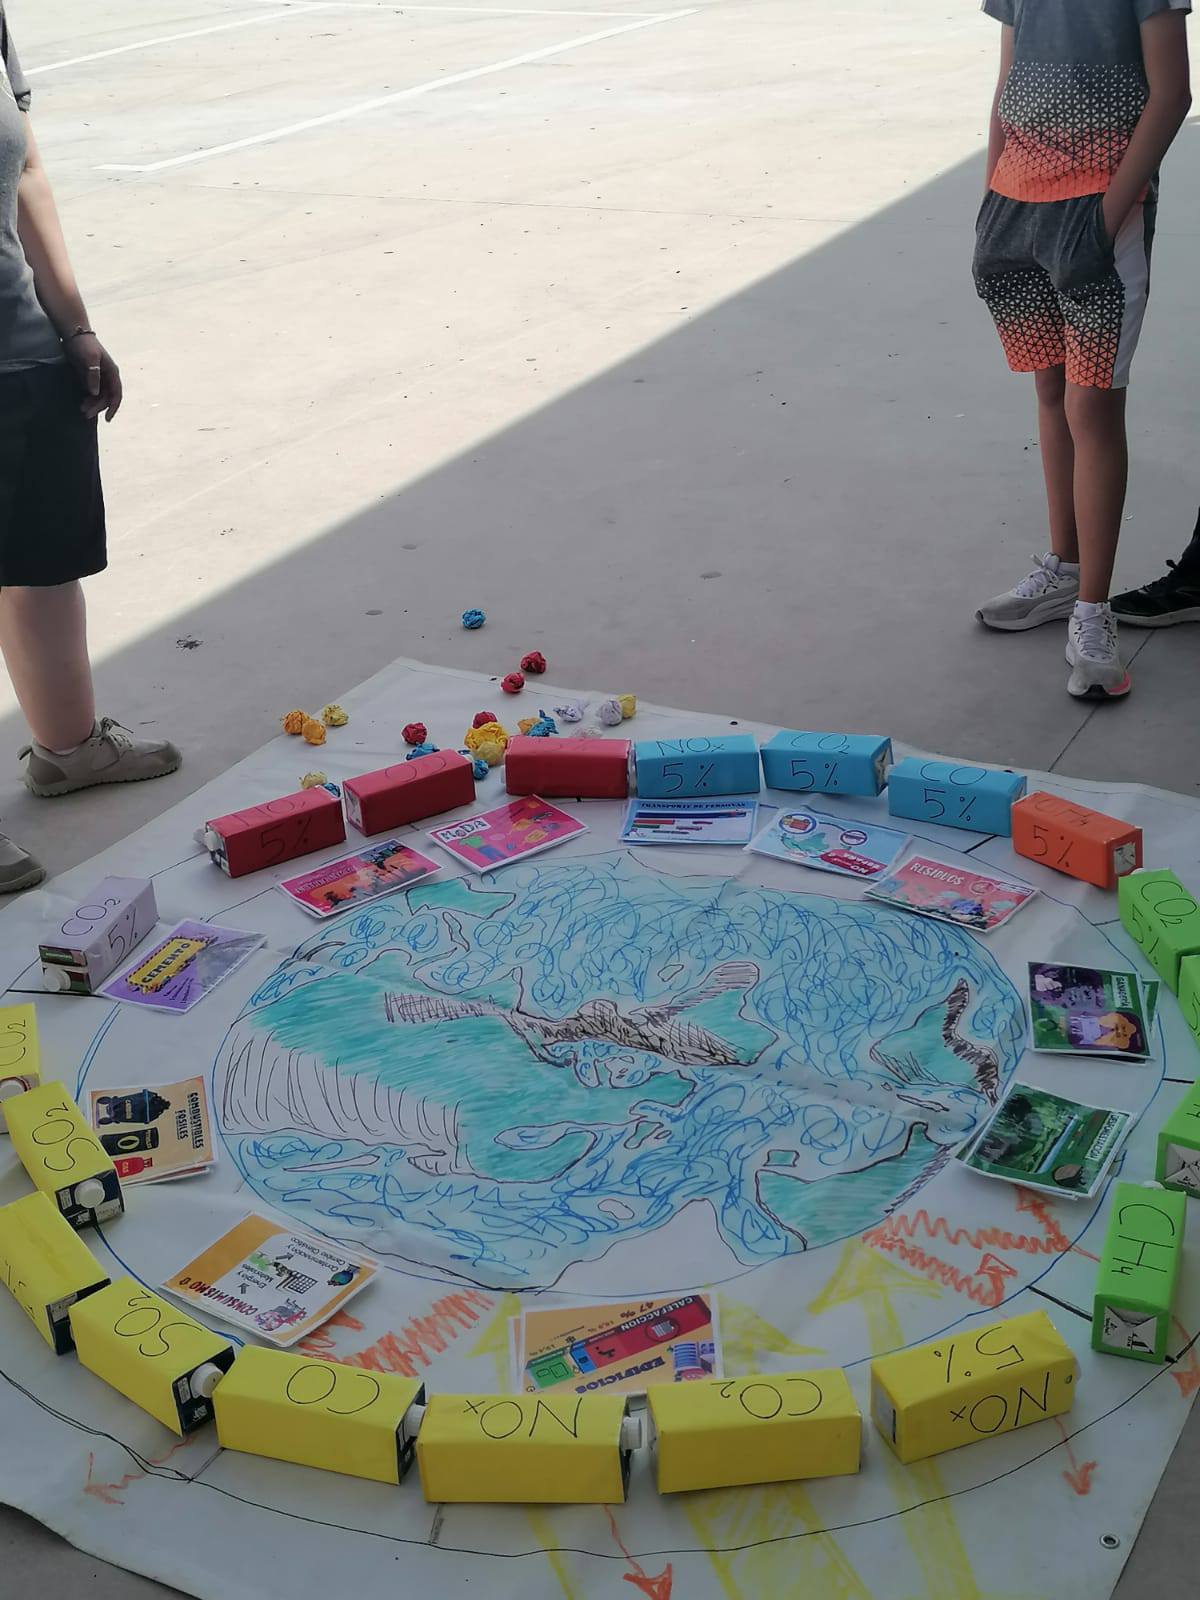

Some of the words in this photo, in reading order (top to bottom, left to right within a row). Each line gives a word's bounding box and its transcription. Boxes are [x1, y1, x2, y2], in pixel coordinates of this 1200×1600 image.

[921, 761, 987, 786] CO
[909, 862, 966, 886] RESIDUOS
[141, 941, 191, 987] CEMENTO
[190, 1091, 205, 1149] COMBUSTIBLES
[190, 1280, 258, 1318] CONSUMISMO
[286, 1364, 380, 1414] CO
[575, 1355, 666, 1395] EDIFICIOS
